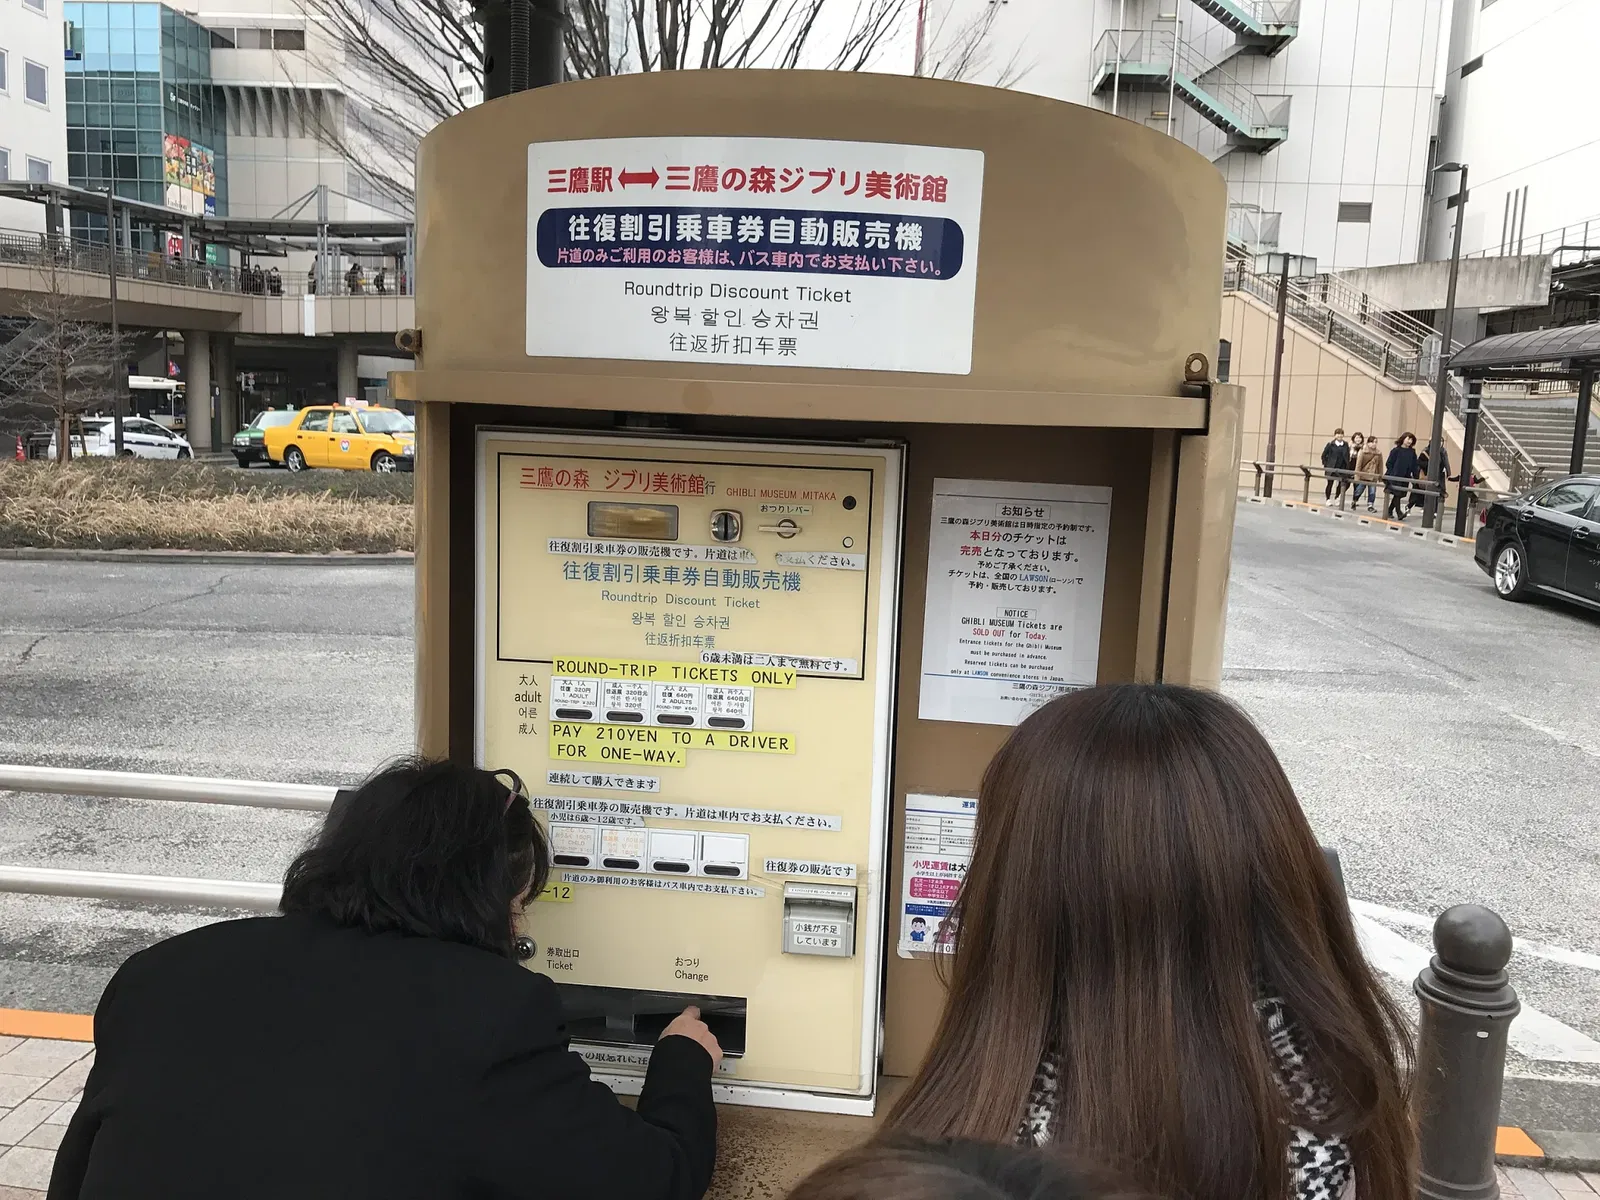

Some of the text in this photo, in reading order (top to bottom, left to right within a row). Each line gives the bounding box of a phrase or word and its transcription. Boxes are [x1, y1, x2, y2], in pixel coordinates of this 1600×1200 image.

[547, 165, 948, 203] 三鷹駅 三鷹の森ジブリ美術館
[568, 214, 923, 251] 往復割引乗車券自動販売機
[556, 247, 943, 276] 片道のみご利用のお客様は、バス車内でお支払い下さい。
[624, 281, 852, 303] Roundtrip Discount Ticket
[650, 305, 820, 330] 왕복 할인 승차권
[668, 332, 799, 356] 往返折扣车票
[519, 467, 590, 490] 三鷹の森
[726, 487, 756, 498] GHIBLI
[760, 489, 797, 500] MUSEUM
[760, 504, 810, 515] おつりレバー
[1002, 505, 1044, 517] お知らせ
[970, 530, 1067, 546] 本日分のチケットは
[960, 545, 1080, 563] 完売となっております。
[977, 560, 1051, 573] 予めご了承ください。
[562, 560, 802, 592] 往復割引乗車券自動販売機
[968, 580, 1057, 594] 予約・販売しております。
[601, 590, 761, 609] Roundtrip Discount Ticket
[631, 611, 731, 630] 왕복 할인 승차권
[1004, 609, 1029, 618] NOTICE
[961, 617, 986, 626] GHIBLI
[989, 618, 1015, 628] MUSEUM
[1018, 620, 1047, 630] Tickets
[972, 627, 990, 637] SOLD
[992, 629, 1006, 638] OUT
[1009, 630, 1021, 639] for
[644, 632, 716, 649] 往返折扣车票
[959, 638, 982, 646] Entrance
[983, 639, 1003, 647] tickets
[1026, 642, 1043, 650] Ghibli
[702, 650, 849, 673] 6歳未満は二人まで無料です。
[964, 659, 987, 667] Reserved
[989, 660, 1008, 668] tickets
[1029, 663, 1054, 672] purchased
[519, 673, 538, 687] 大人
[556, 660, 794, 686] ROUND-TRIP TICKETS ONLY
[990, 671, 1021, 679] convenience
[1023, 673, 1040, 681] stores
[515, 690, 542, 703] adult
[518, 707, 538, 720] 어른
[518, 723, 538, 736] 成人
[553, 724, 789, 750] PAY 210YEN TO A DRIVER
[557, 744, 682, 764] FOR ONE-WAY.
[548, 772, 657, 791] 連続して購入できます
[765, 859, 854, 877] 往復券の販売です
[794, 923, 838, 935] 小銭が不足
[796, 935, 838, 947] しています
[547, 947, 580, 959] 券取出口
[547, 959, 574, 971] Ticket
[674, 956, 701, 968] おつり
[674, 969, 709, 982] Change
